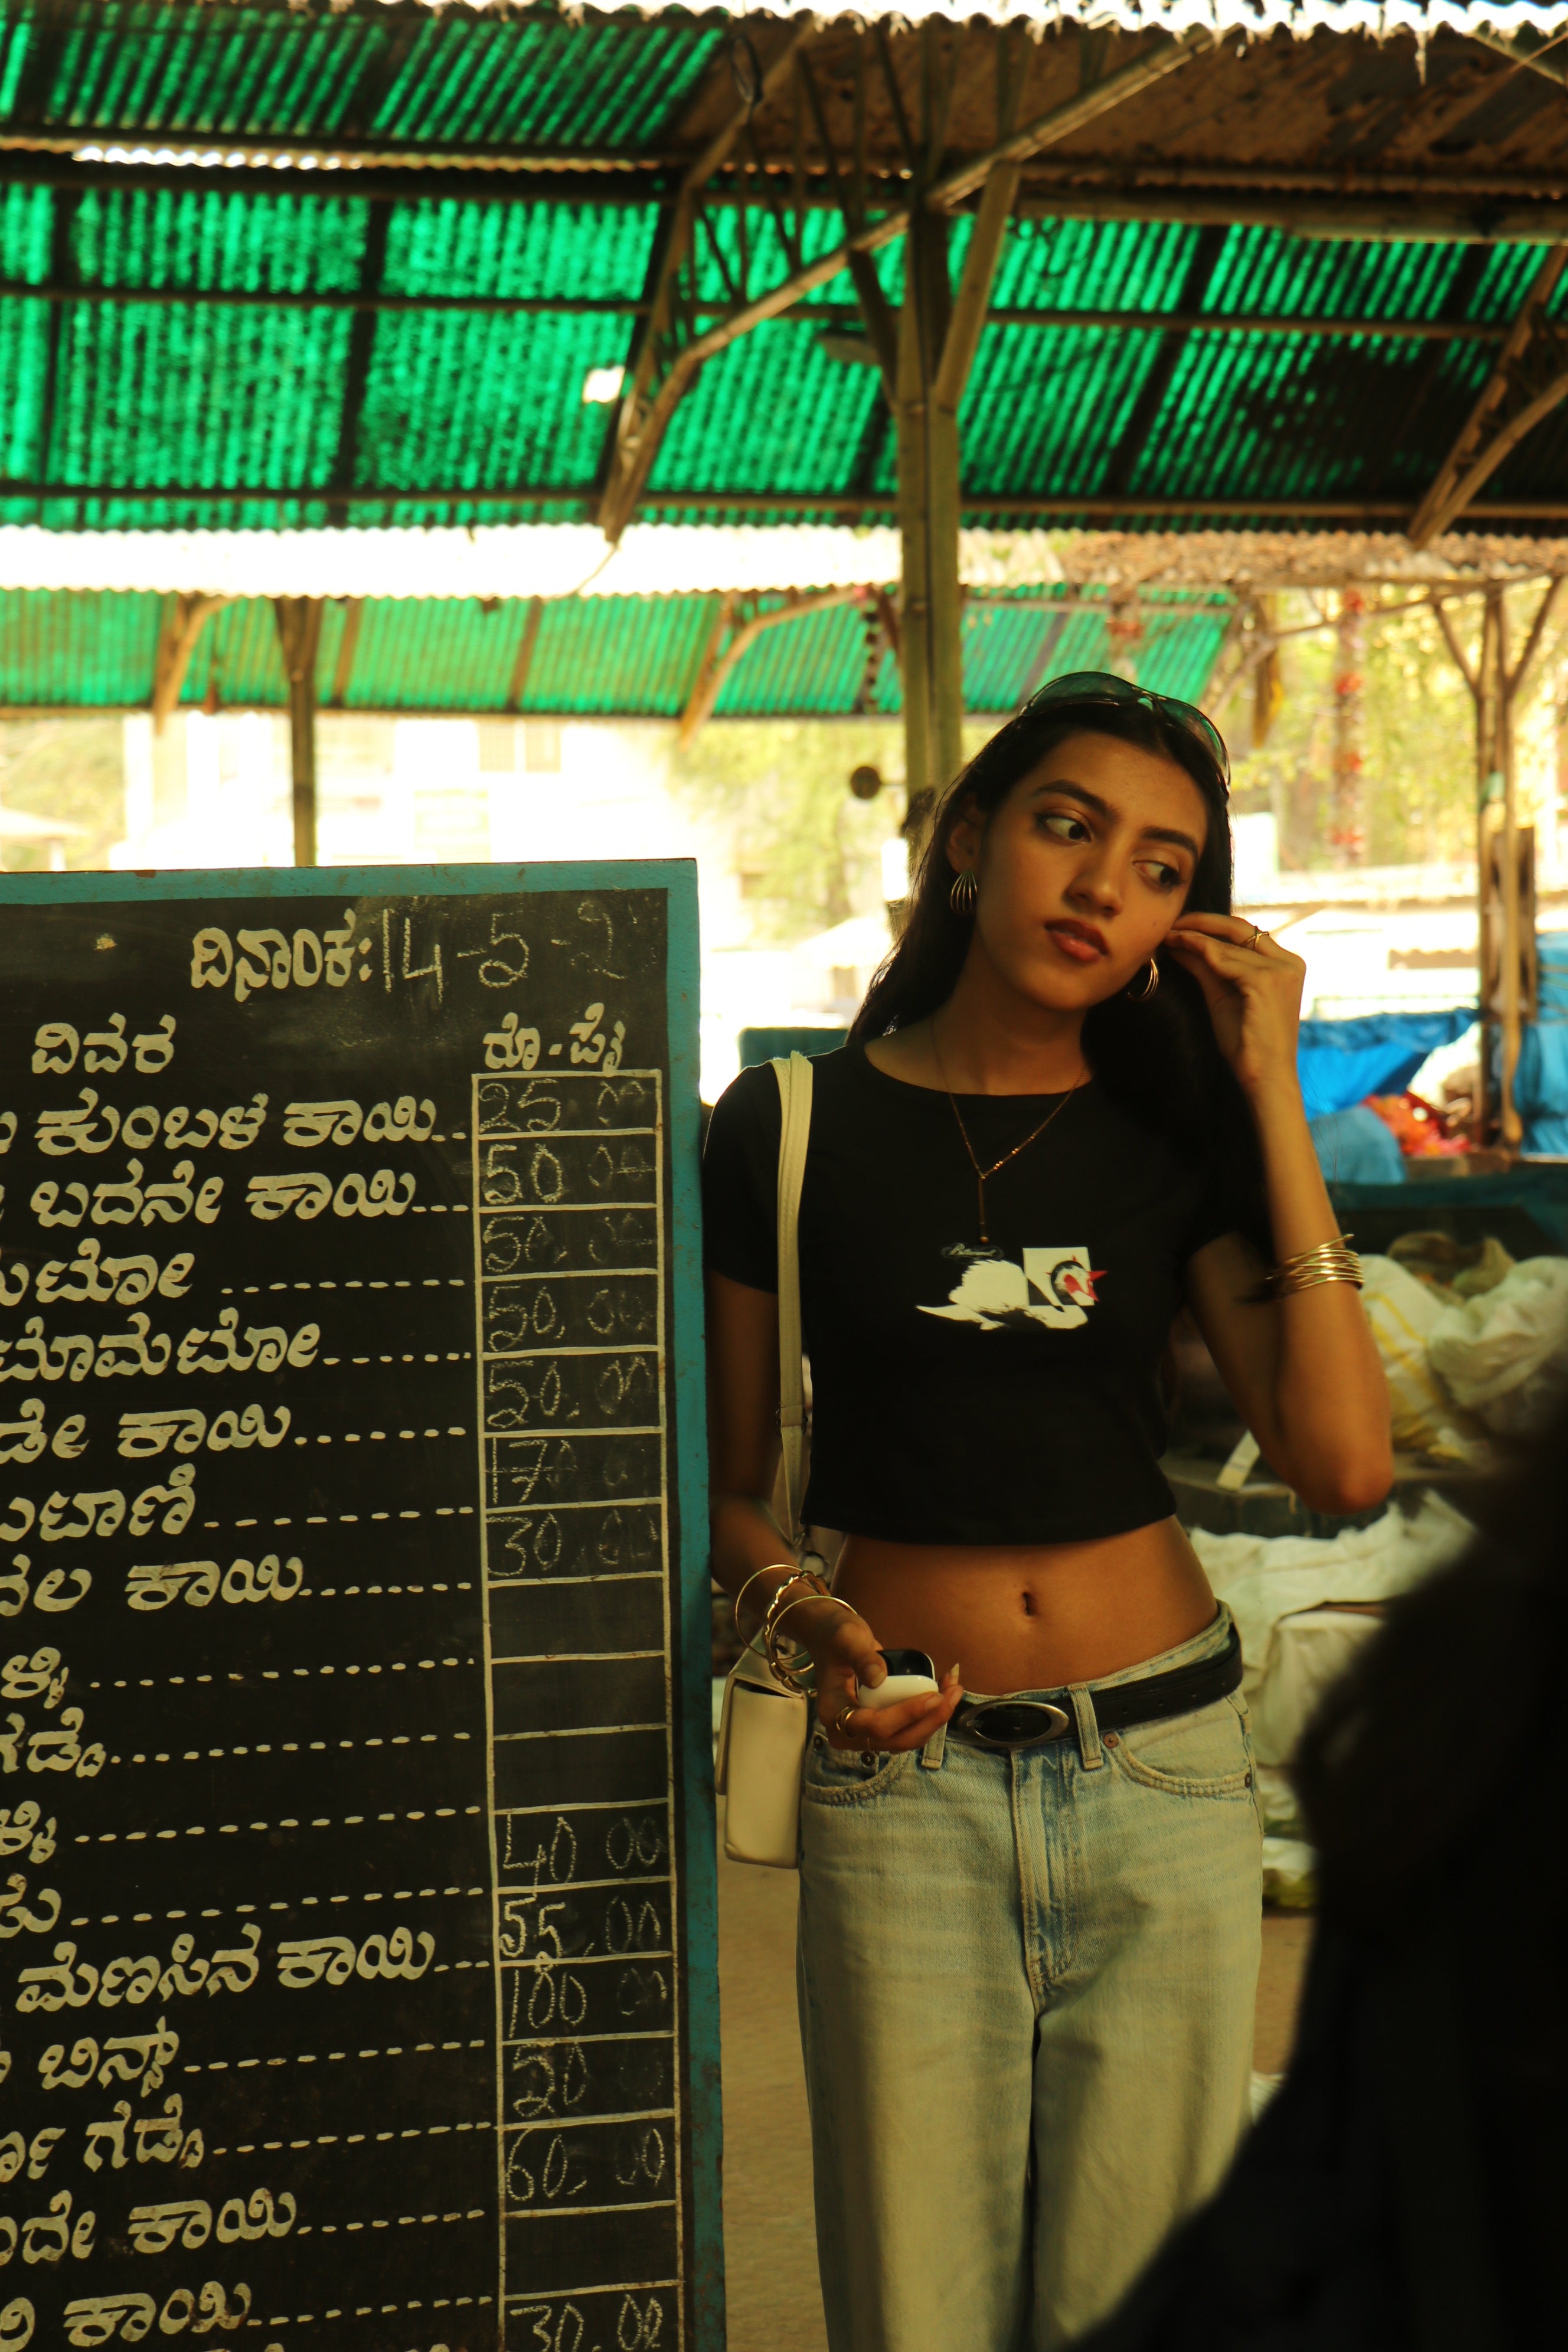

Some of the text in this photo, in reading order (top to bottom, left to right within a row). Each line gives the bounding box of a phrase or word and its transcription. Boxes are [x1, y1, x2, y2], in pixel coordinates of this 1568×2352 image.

[31, 1012, 176, 1073] ವಿವರ
[34, 1087, 269, 1155] ಕುಂಬಳ
[283, 1095, 436, 1148] ಕಾಯಿ
[30, 1158, 224, 1227] ಬದನೇ
[246, 1169, 416, 1220] ಕಾಯಿ
[483, 1142, 564, 1204] 50
[117, 1403, 291, 1458] ಕಾಯಿ
[125, 1554, 303, 1611] ಕಾಯಿ
[15, 1923, 262, 2013] ಮೆಣಸಿನ
[277, 1926, 435, 1988] ಕಾಯಿ
[509, 1968, 587, 2039] 100
[128, 2187, 296, 2253] ಕಾಯಿ
[63, 2281, 251, 2347] ಕಾಯಿ
